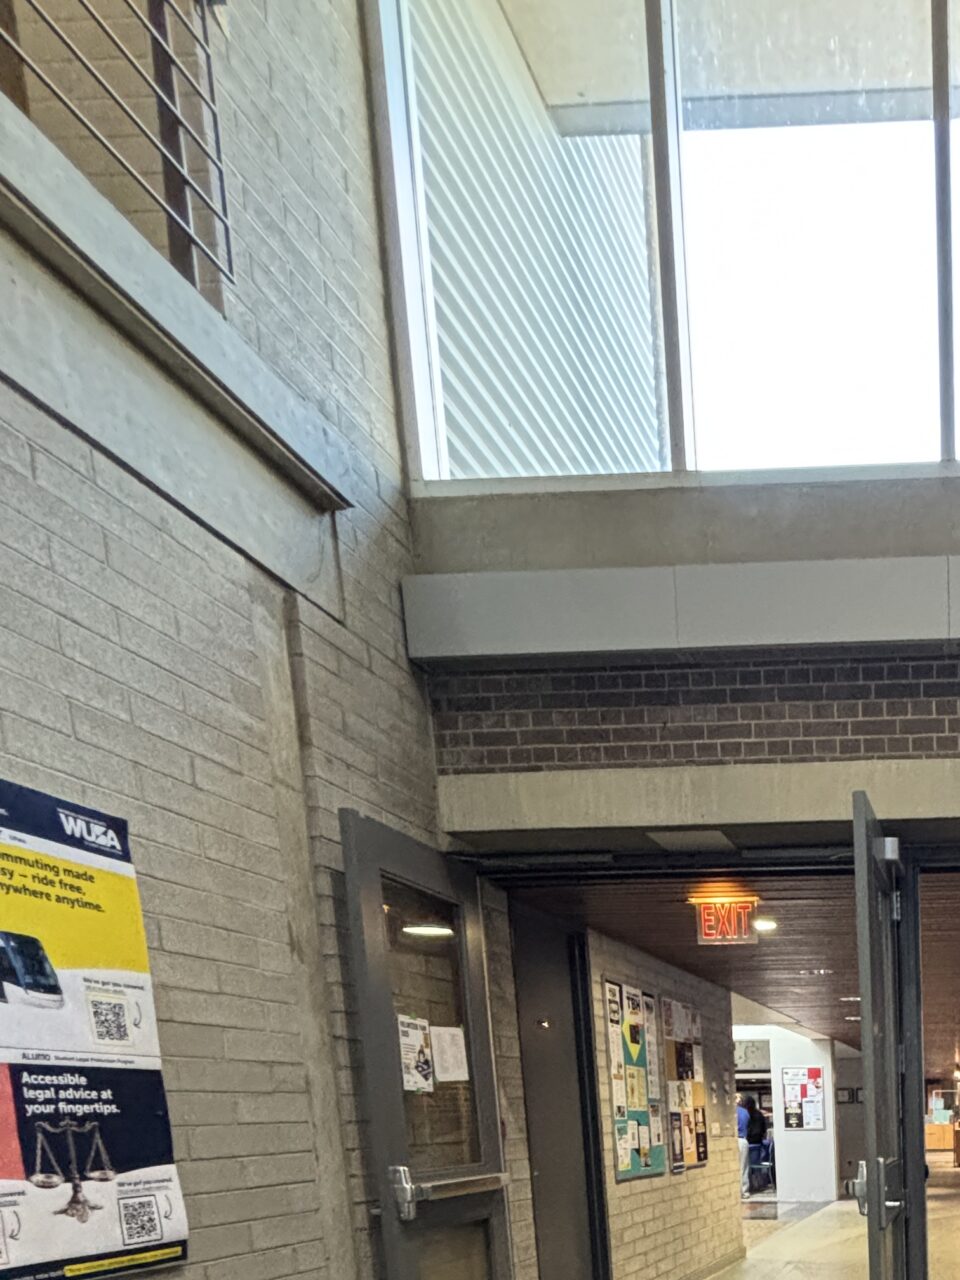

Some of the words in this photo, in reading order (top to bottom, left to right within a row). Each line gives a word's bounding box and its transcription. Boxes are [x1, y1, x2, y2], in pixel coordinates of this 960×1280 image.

[63, 867, 95, 884] made
[32, 873, 56, 888] ride
[59, 879, 86, 896] free,
[55, 895, 106, 913] anytime.
[701, 903, 752, 939] EXIT
[22, 1071, 88, 1085] Accessible
[23, 1087, 56, 1101] legal
[58, 1088, 98, 1099] advice
[100, 1089, 113, 1100] at
[25, 1104, 56, 1116] your
[58, 1102, 120, 1115] fingertips.
